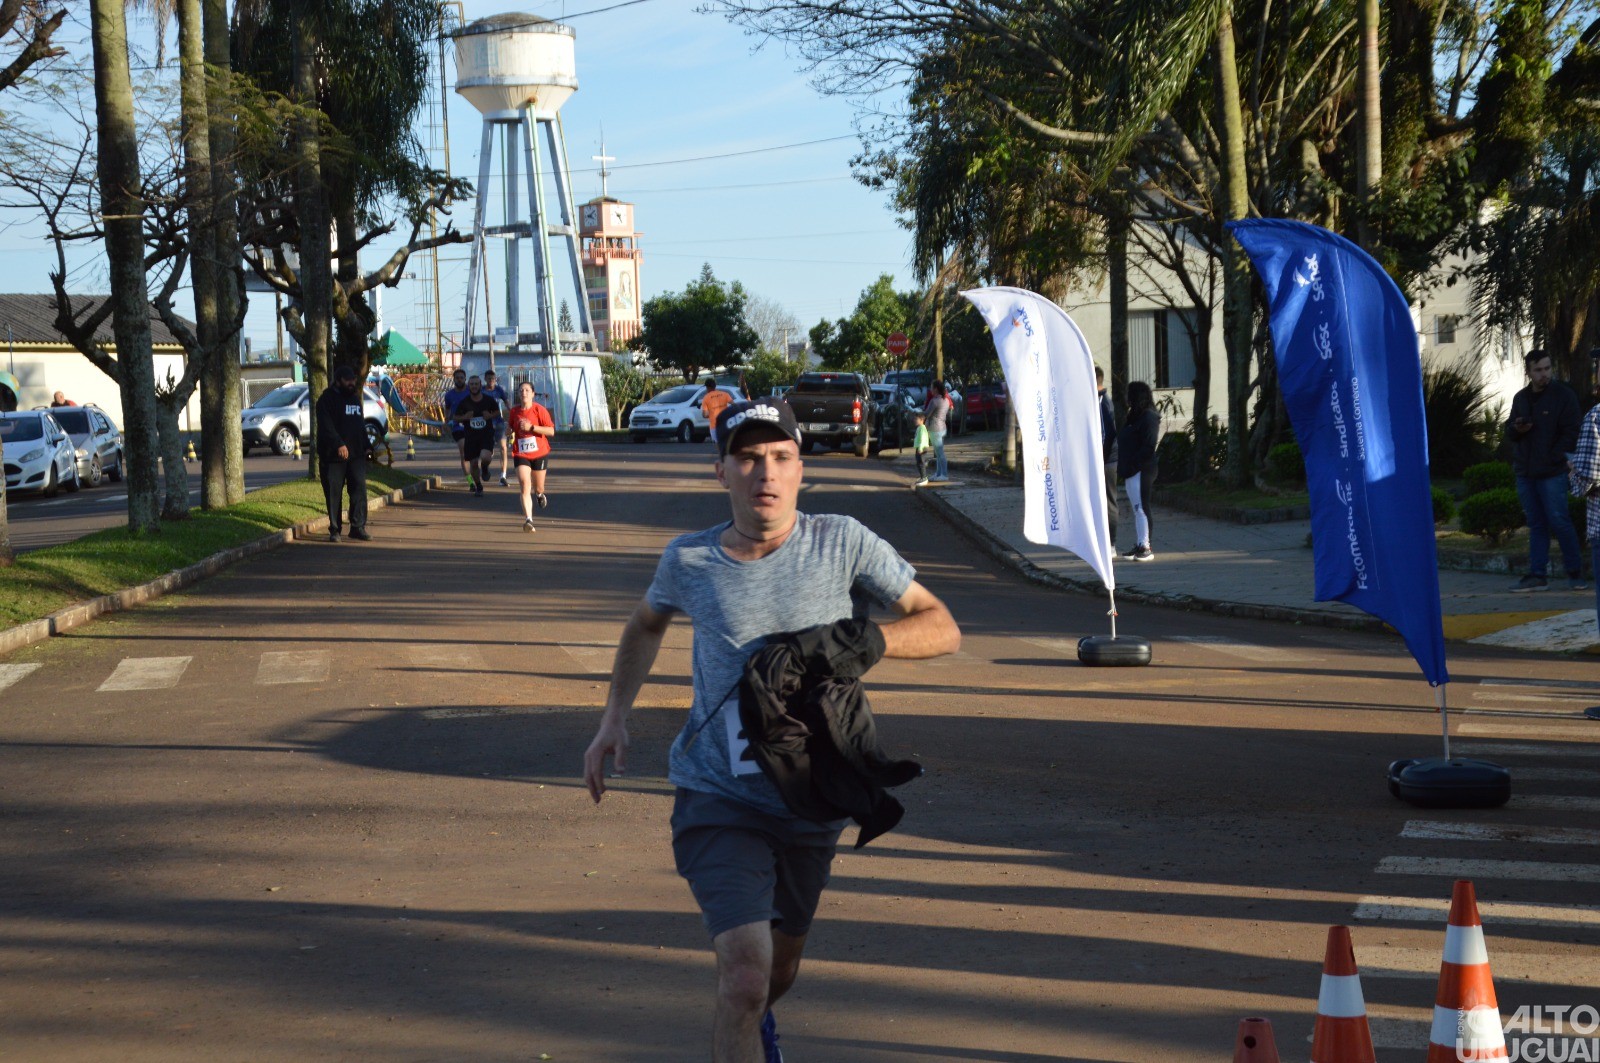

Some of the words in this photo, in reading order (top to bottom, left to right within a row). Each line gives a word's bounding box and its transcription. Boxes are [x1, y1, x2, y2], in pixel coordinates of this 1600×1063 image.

[1304, 253, 1325, 301] Senac
[1319, 322, 1332, 360] Sesc
[345, 404, 361, 416] UFC
[726, 404, 780, 429] apollo
[1330, 380, 1349, 458] Sindicatos
[520, 442, 536, 451] 175
[1355, 422, 1366, 461] Sistema
[1041, 457, 1050, 471] RS
[1043, 473, 1060, 531] Fecomércio
